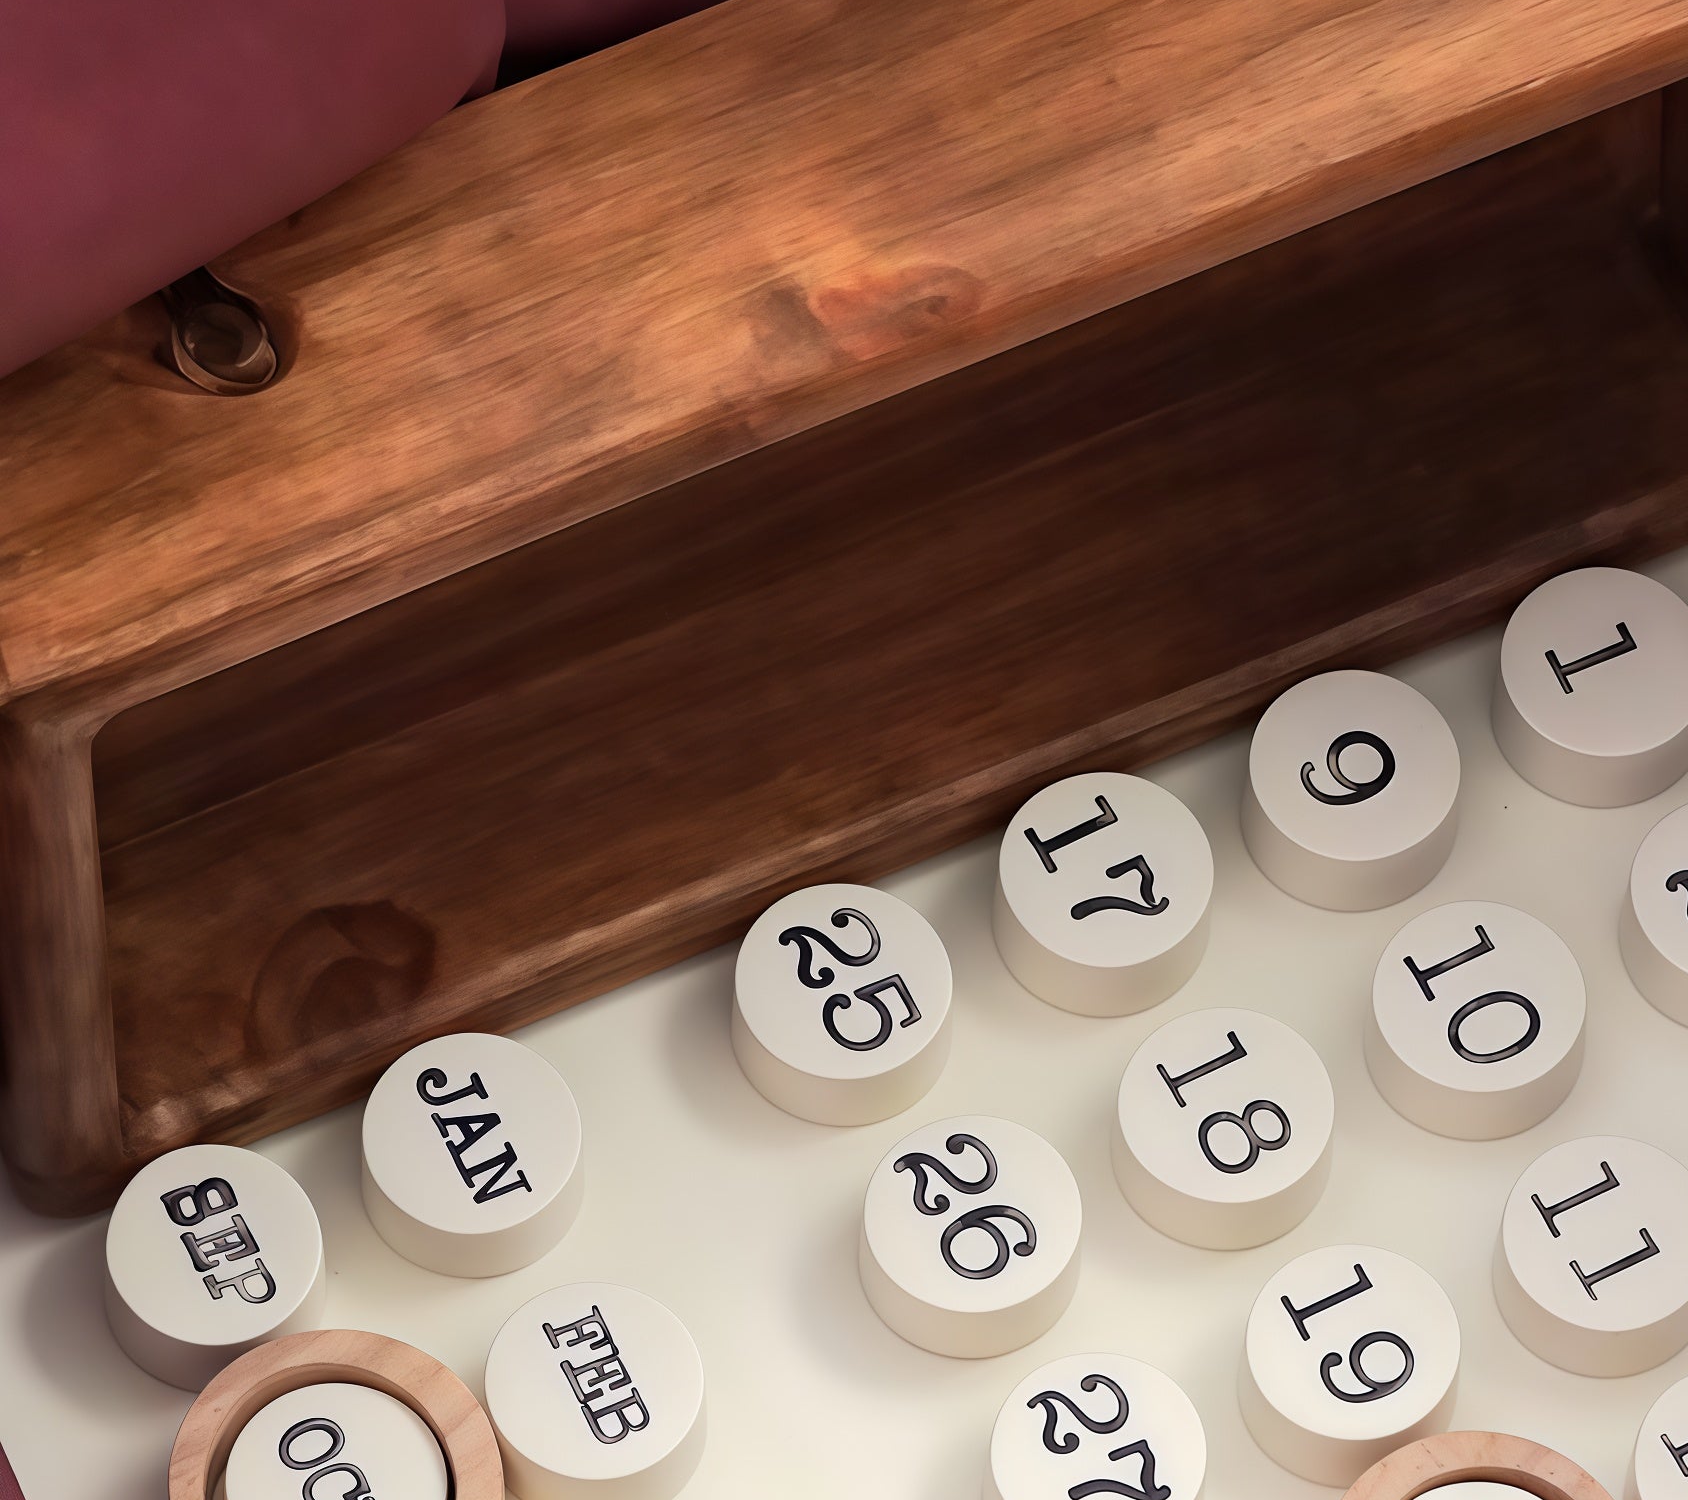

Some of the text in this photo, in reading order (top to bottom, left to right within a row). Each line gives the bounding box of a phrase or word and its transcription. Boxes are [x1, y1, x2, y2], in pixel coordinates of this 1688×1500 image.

[1545, 622, 1637, 694] 1
[1300, 731, 1395, 805] 9
[1024, 795, 1169, 920] 17
[779, 908, 922, 1051] 25
[1403, 925, 1541, 1064] 10
[416, 1068, 532, 1204] JAN
[1156, 1031, 1291, 1174] 18
[893, 1134, 1037, 1280] 26
[1531, 1161, 1660, 1301] 11
[542, 1305, 650, 1444] FEB
[1280, 1264, 1414, 1403] 19
